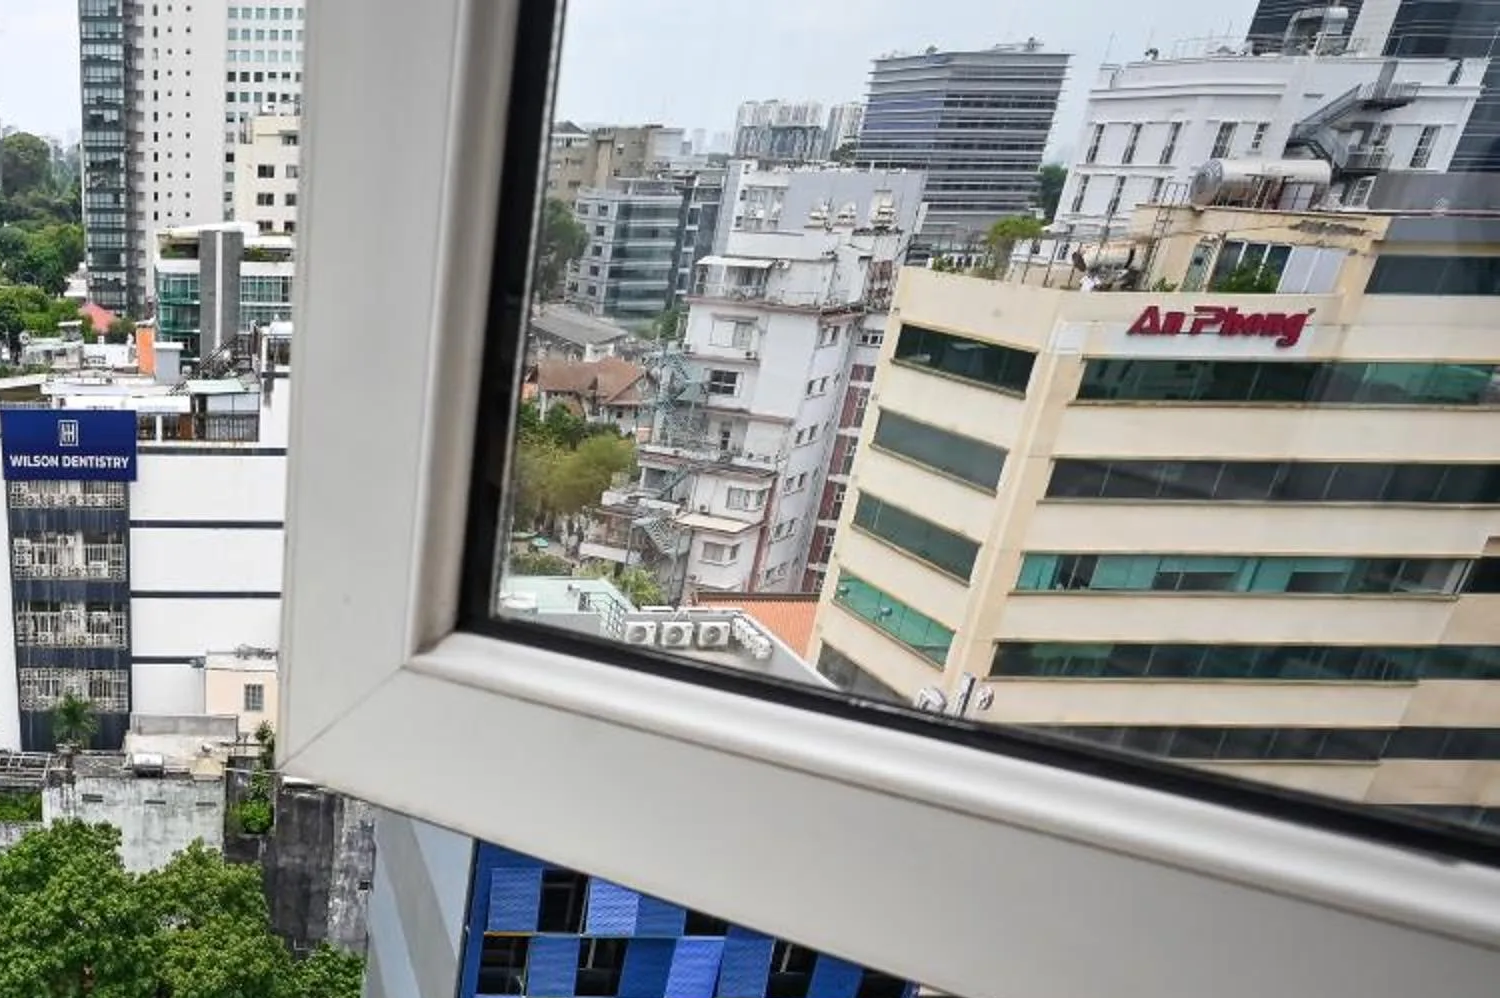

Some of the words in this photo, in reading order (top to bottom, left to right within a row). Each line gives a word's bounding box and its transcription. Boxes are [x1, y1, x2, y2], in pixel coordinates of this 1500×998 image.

[1126, 305, 1187, 335] An
[1190, 305, 1310, 347] Phong
[9, 454, 59, 467] WILSON
[62, 455, 130, 469] DENTISTRY
